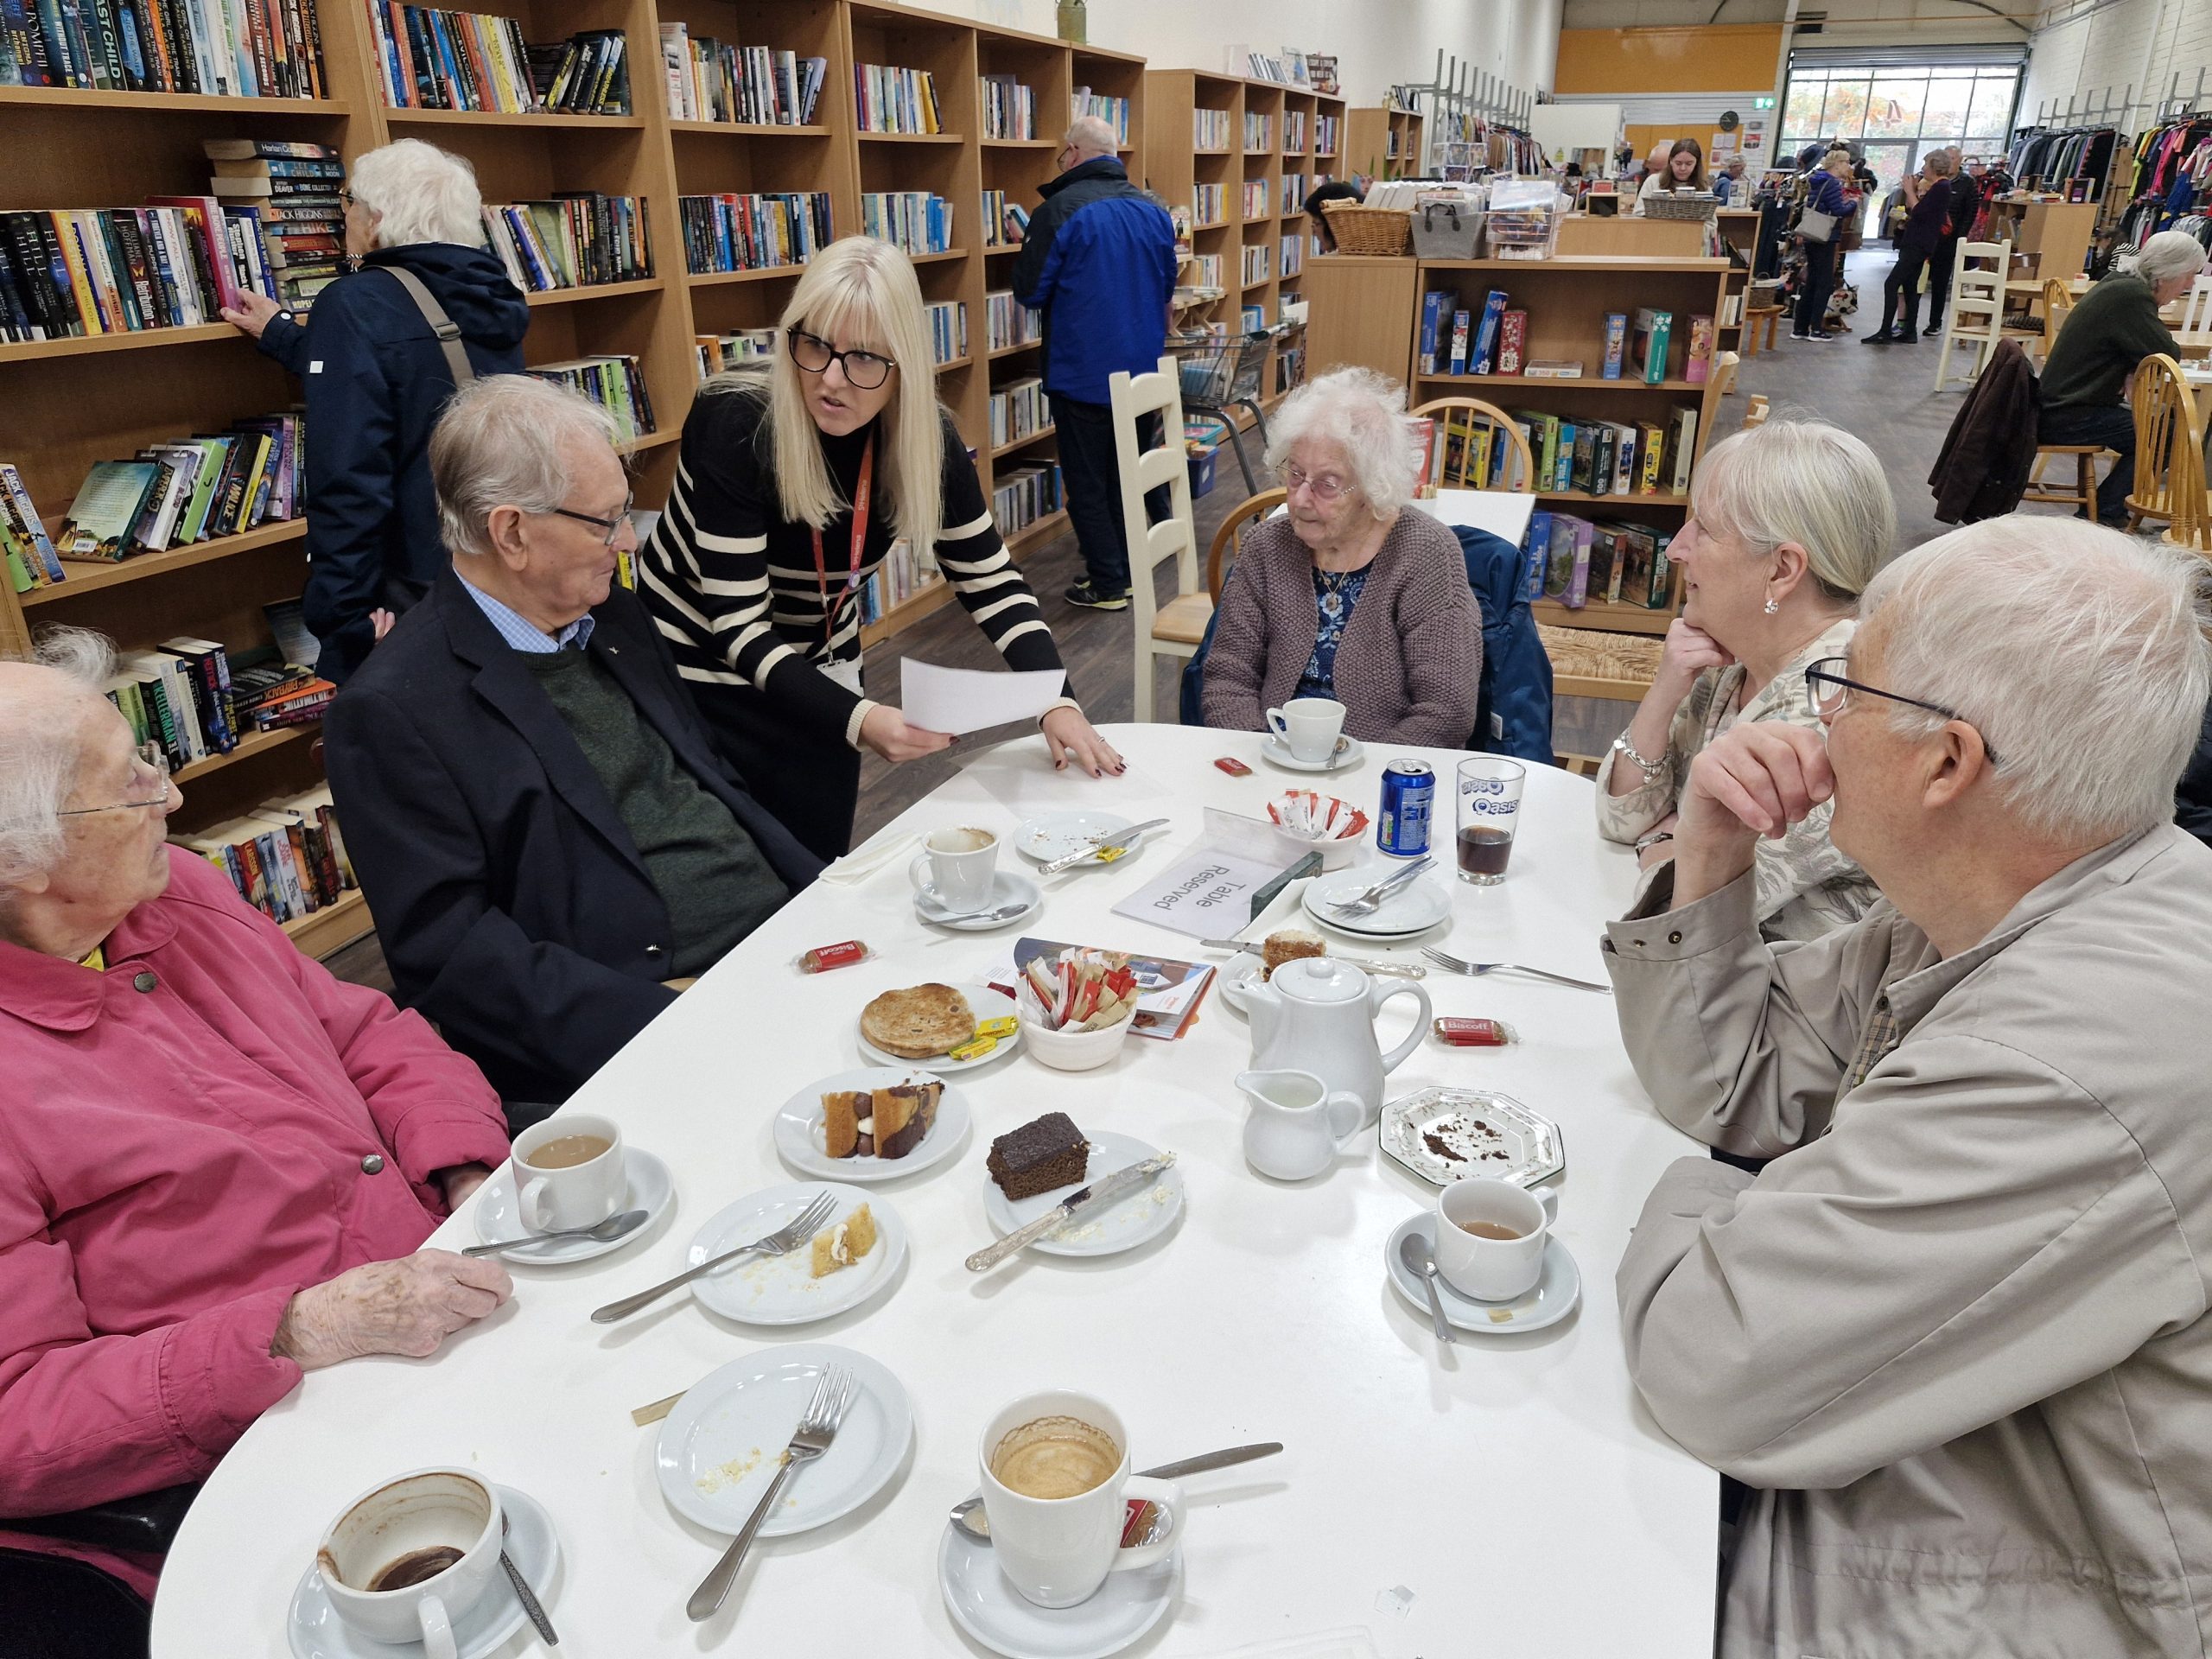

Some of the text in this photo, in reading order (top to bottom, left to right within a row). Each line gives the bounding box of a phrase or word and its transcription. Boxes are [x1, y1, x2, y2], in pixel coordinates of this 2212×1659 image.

[163, 10, 172, 28] GIRL
[168, 29, 174, 41] ON
[184, 29, 191, 41] ON
[289, 10, 303, 44] HIGGINS
[302, 12, 314, 48] HIGGINS
[309, 15, 321, 45] HIGGINS
[515, 21, 524, 46] PETER
[19, 29, 32, 66] ENIGMA
[54, 20, 68, 52] WITHOUT
[61, 51, 73, 74] TRACE
[102, 29, 121, 79] CHILD
[148, 28, 155, 39] ON
[154, 55, 162, 77] TRAIN
[255, 35, 265, 56] THREE
[258, 56, 270, 87] SECONDS
[458, 39, 476, 96] EVIL GAMES
[261, 143, 283, 152] Harlan
[275, 184, 294, 193] DEAVER
[1489, 173, 1513, 181] LONDON
[208, 200, 219, 216] THE
[276, 207, 323, 219] JACK HIGGINS
[150, 219, 162, 240] FOREVER
[156, 239, 165, 251] AND
[164, 212, 181, 261] SNOW FALL
[212, 215, 222, 233] BONE
[255, 217, 266, 250] DOCTOR'S
[303, 223, 335, 234] HIKE
[16, 234, 35, 276] HILL
[26, 229, 48, 277] HILL
[43, 228, 67, 279] HILL
[216, 232, 228, 260] PEOPLE
[232, 223, 248, 284] Stephen Black
[60, 217, 95, 324] MAESTRA HILTON
[120, 225, 157, 321] HOFFMAN Retribution
[147, 245, 160, 276] PUPPET
[155, 276, 168, 309] MASTER
[106, 281, 115, 294] TOM
[110, 294, 120, 315] HINDLE
[265, 438, 278, 467] JEWELL
[5, 468, 37, 526] JACK HIGGINS
[155, 466, 174, 500] EMPEROR
[172, 486, 185, 509] BLOOD
[1596, 478, 1605, 494] 500
[222, 483, 243, 520] MALICE
[213, 651, 225, 678] KERNICK
[219, 652, 229, 675] SIMON
[264, 680, 298, 701] PAYBACK
[154, 684, 177, 743] KELLERMAN
[212, 691, 225, 728] FINAL MINUTE
[1472, 798, 1520, 815] Oasis
[242, 843, 260, 876] LARSSON
[1154, 864, 1230, 911] Reserved
[1196, 882, 1246, 907] Table
[819, 942, 855, 957] Biscoff
[1448, 1021, 1488, 1030] Biscoff
